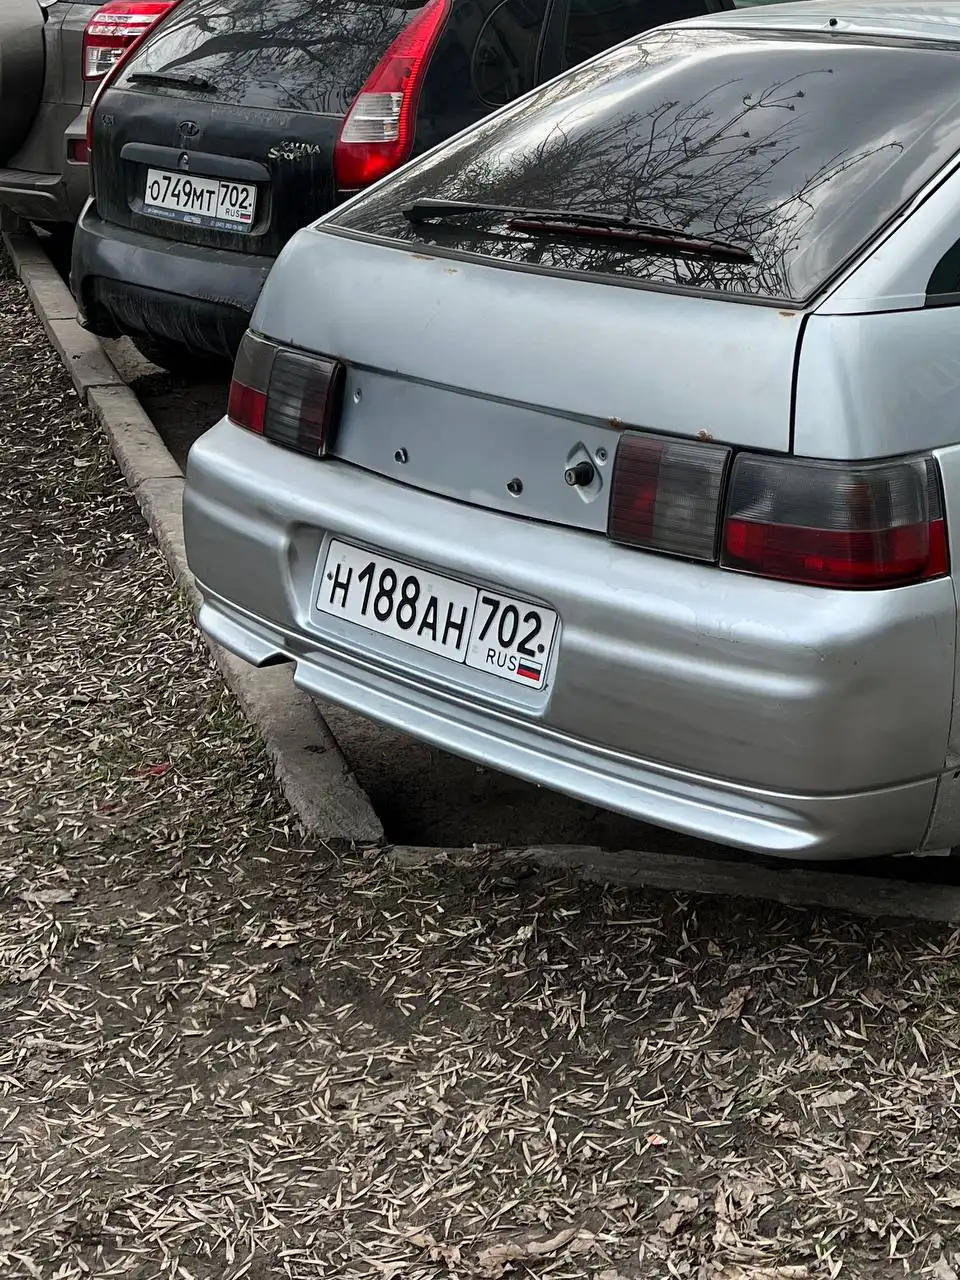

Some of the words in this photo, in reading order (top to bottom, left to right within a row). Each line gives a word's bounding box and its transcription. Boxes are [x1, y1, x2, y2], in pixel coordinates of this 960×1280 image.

[220, 184, 249, 209] 702
[225, 207, 240, 217] RUS
[478, 595, 542, 657] 702
[485, 648, 517, 671] RUS
